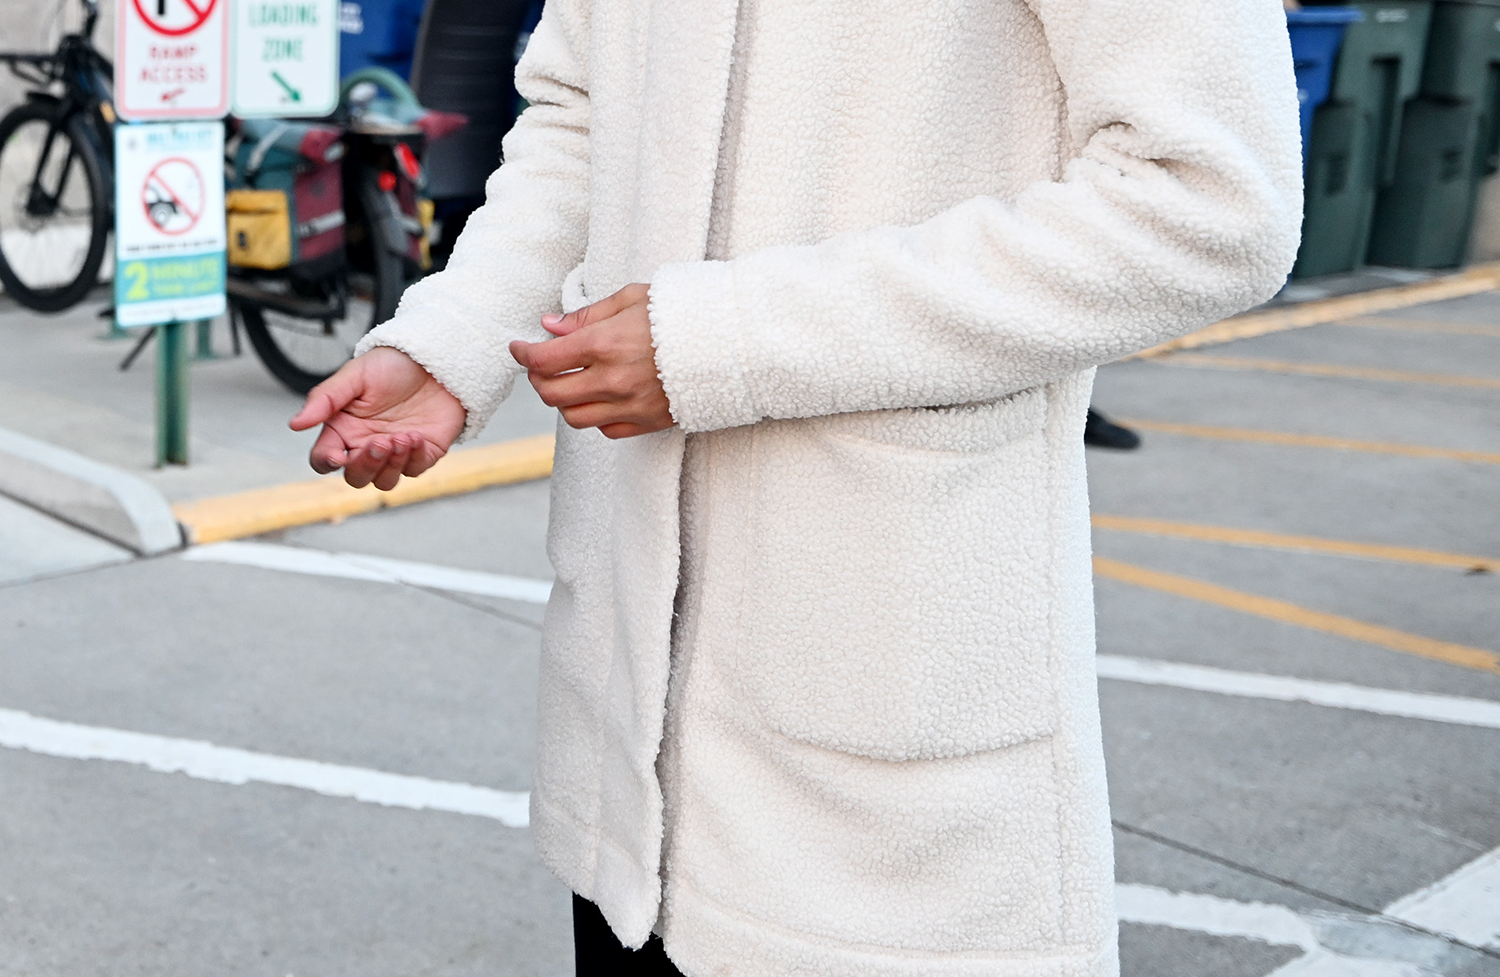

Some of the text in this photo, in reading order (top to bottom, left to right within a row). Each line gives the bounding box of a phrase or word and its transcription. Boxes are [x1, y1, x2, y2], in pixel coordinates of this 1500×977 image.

[250, 3, 318, 26] LOADING
[150, 45, 198, 60] RAMP
[263, 37, 303, 60] ZONE
[140, 66, 207, 83] ACCESS
[124, 261, 149, 301] 2
